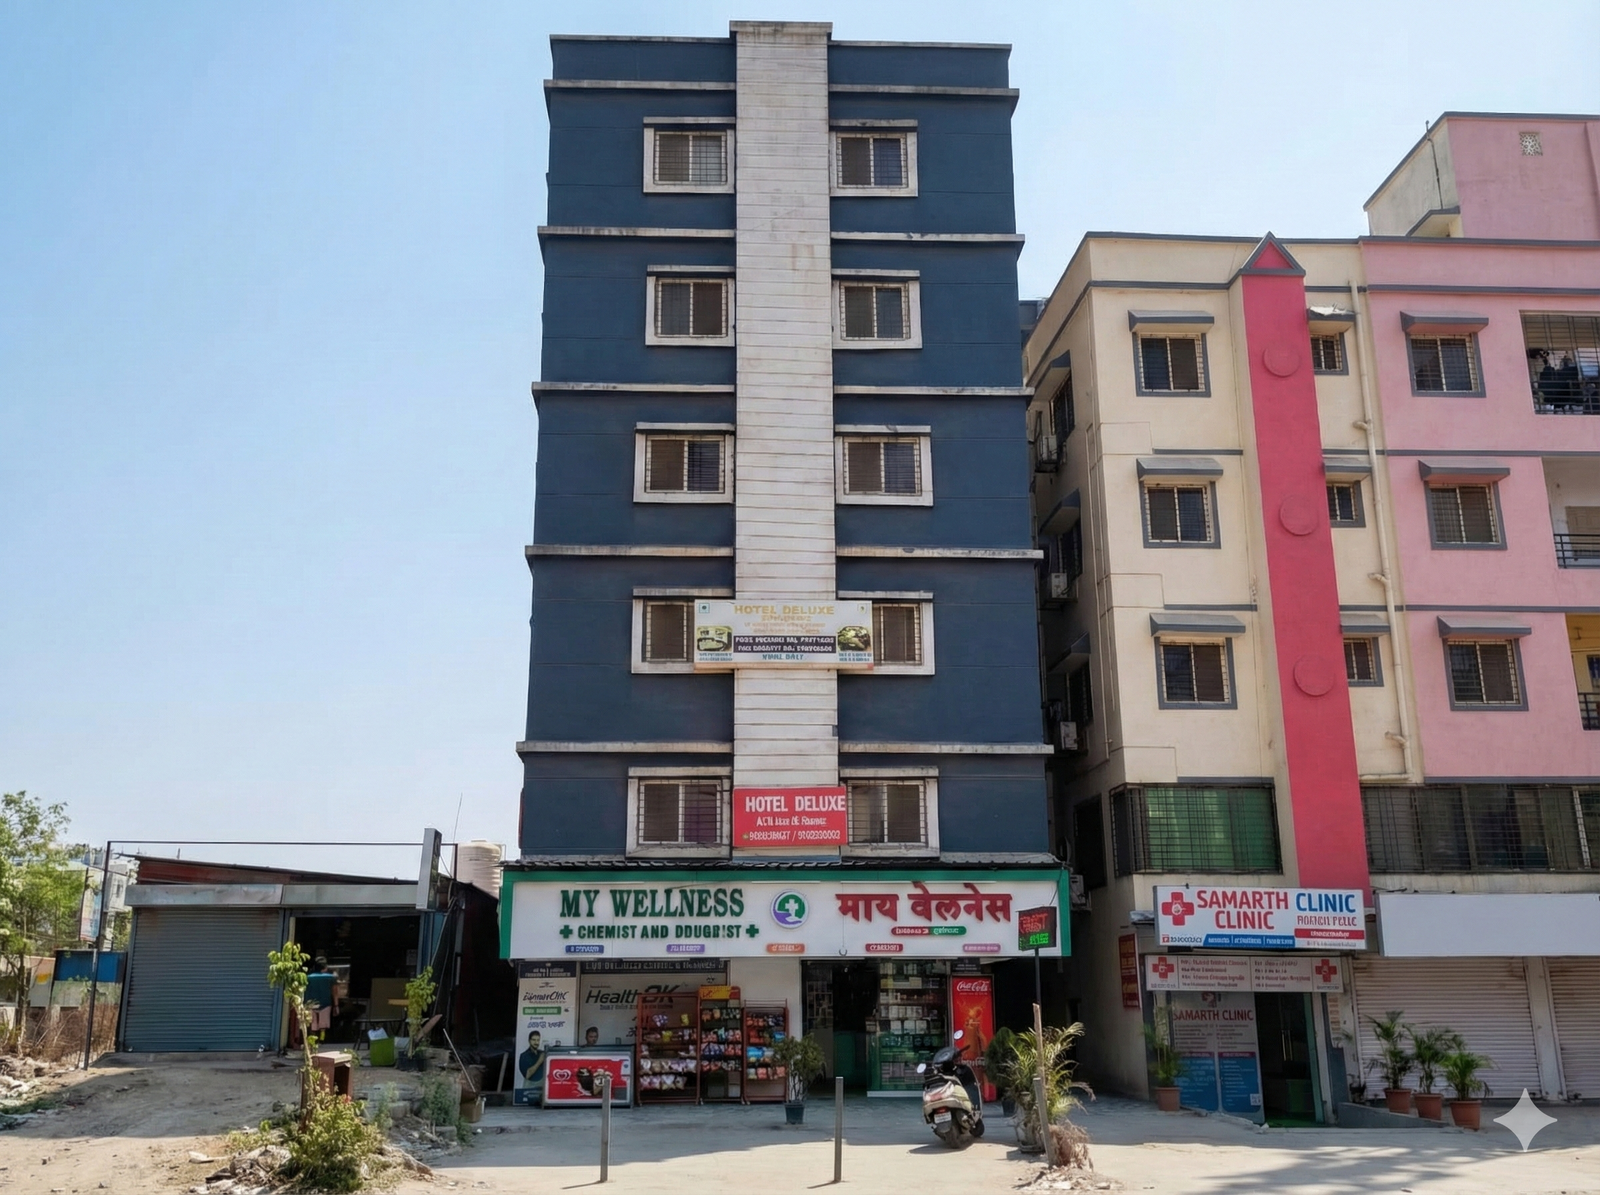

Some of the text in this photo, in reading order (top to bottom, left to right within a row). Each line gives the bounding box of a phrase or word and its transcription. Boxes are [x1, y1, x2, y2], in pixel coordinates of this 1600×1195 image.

[734, 605, 835, 615] HOTEL DELUXE
[745, 795, 846, 812] HOTEL DELUXE
[560, 888, 745, 917] MY WELLNESS
[835, 881, 1013, 922] माय वेलनेस
[1197, 890, 1356, 913] SAMARTH CLINIC
[1215, 910, 1275, 930] CLINIC
[577, 925, 637, 939] CHEMIST
[640, 925, 669, 939] AND
[1222, 1010, 1254, 1021] CLINIC
